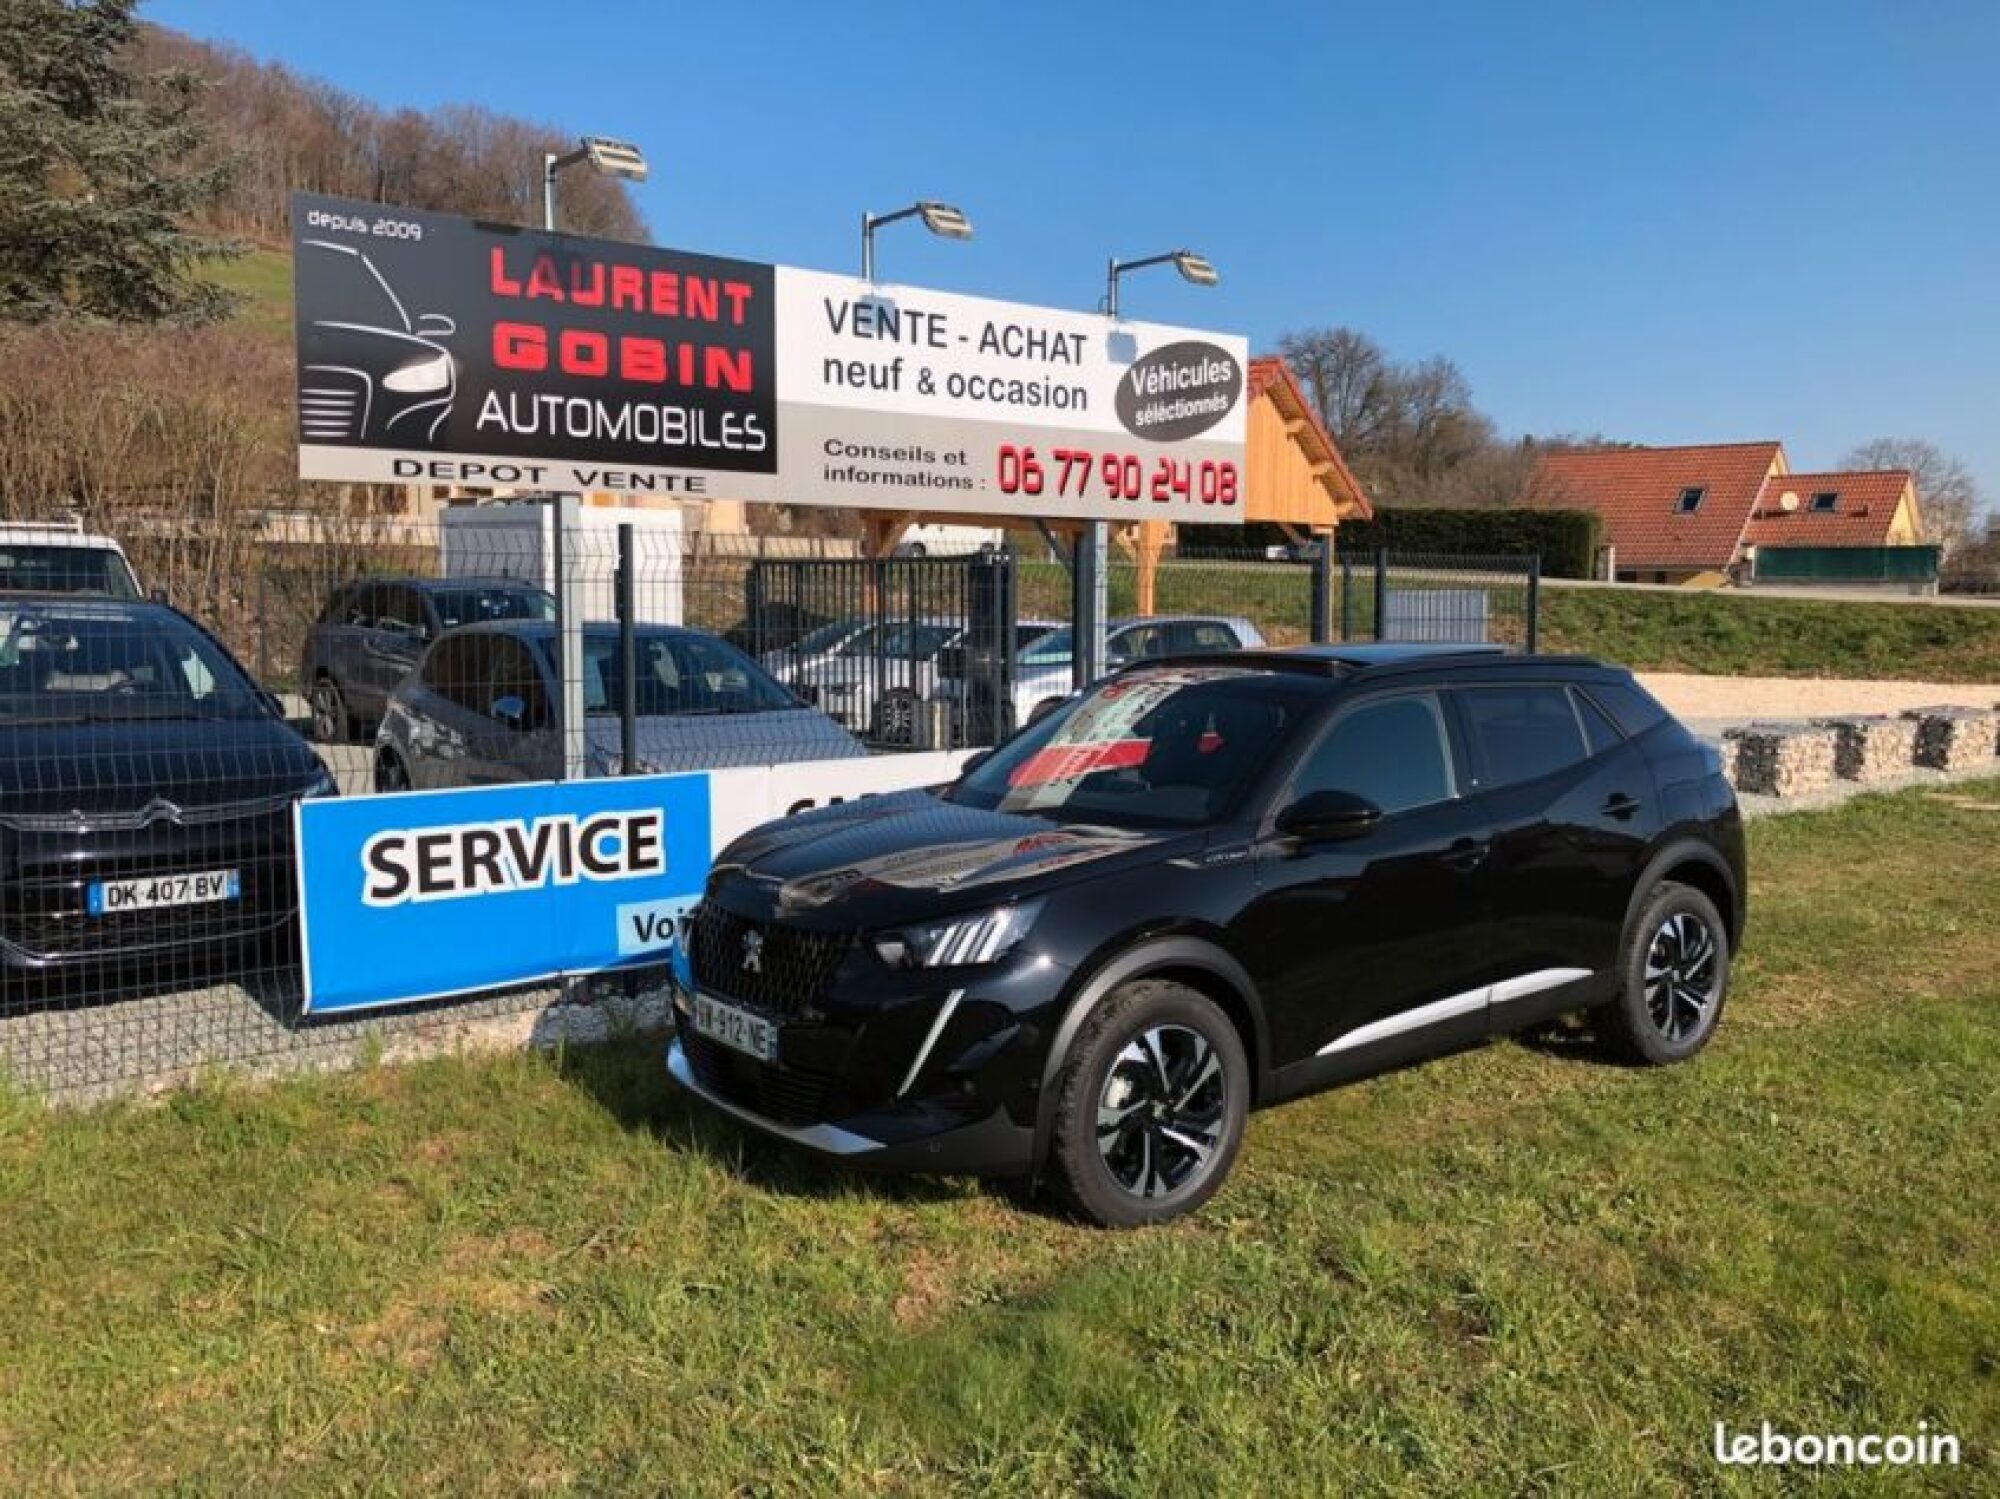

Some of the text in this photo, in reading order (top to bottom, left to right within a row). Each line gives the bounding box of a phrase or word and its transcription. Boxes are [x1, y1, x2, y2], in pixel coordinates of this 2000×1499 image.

[307, 209, 422, 242] depuis 2009
[489, 245, 754, 326] LAURENT
[491, 319, 754, 393] GOBIN
[823, 298, 949, 349] VENTE
[978, 320, 1088, 367] ACHAT
[822, 356, 1088, 412] neuf & occasion
[1130, 355, 1232, 398] Véhicules
[475, 389, 767, 452] AUTOMOBILES
[391, 457, 708, 494] DEPOT VENTE
[822, 437, 968, 467] Conseils et
[822, 464, 975, 491] informations
[996, 442, 1239, 507] 06 77 90 24 08
[366, 811, 662, 902] SERVICE
